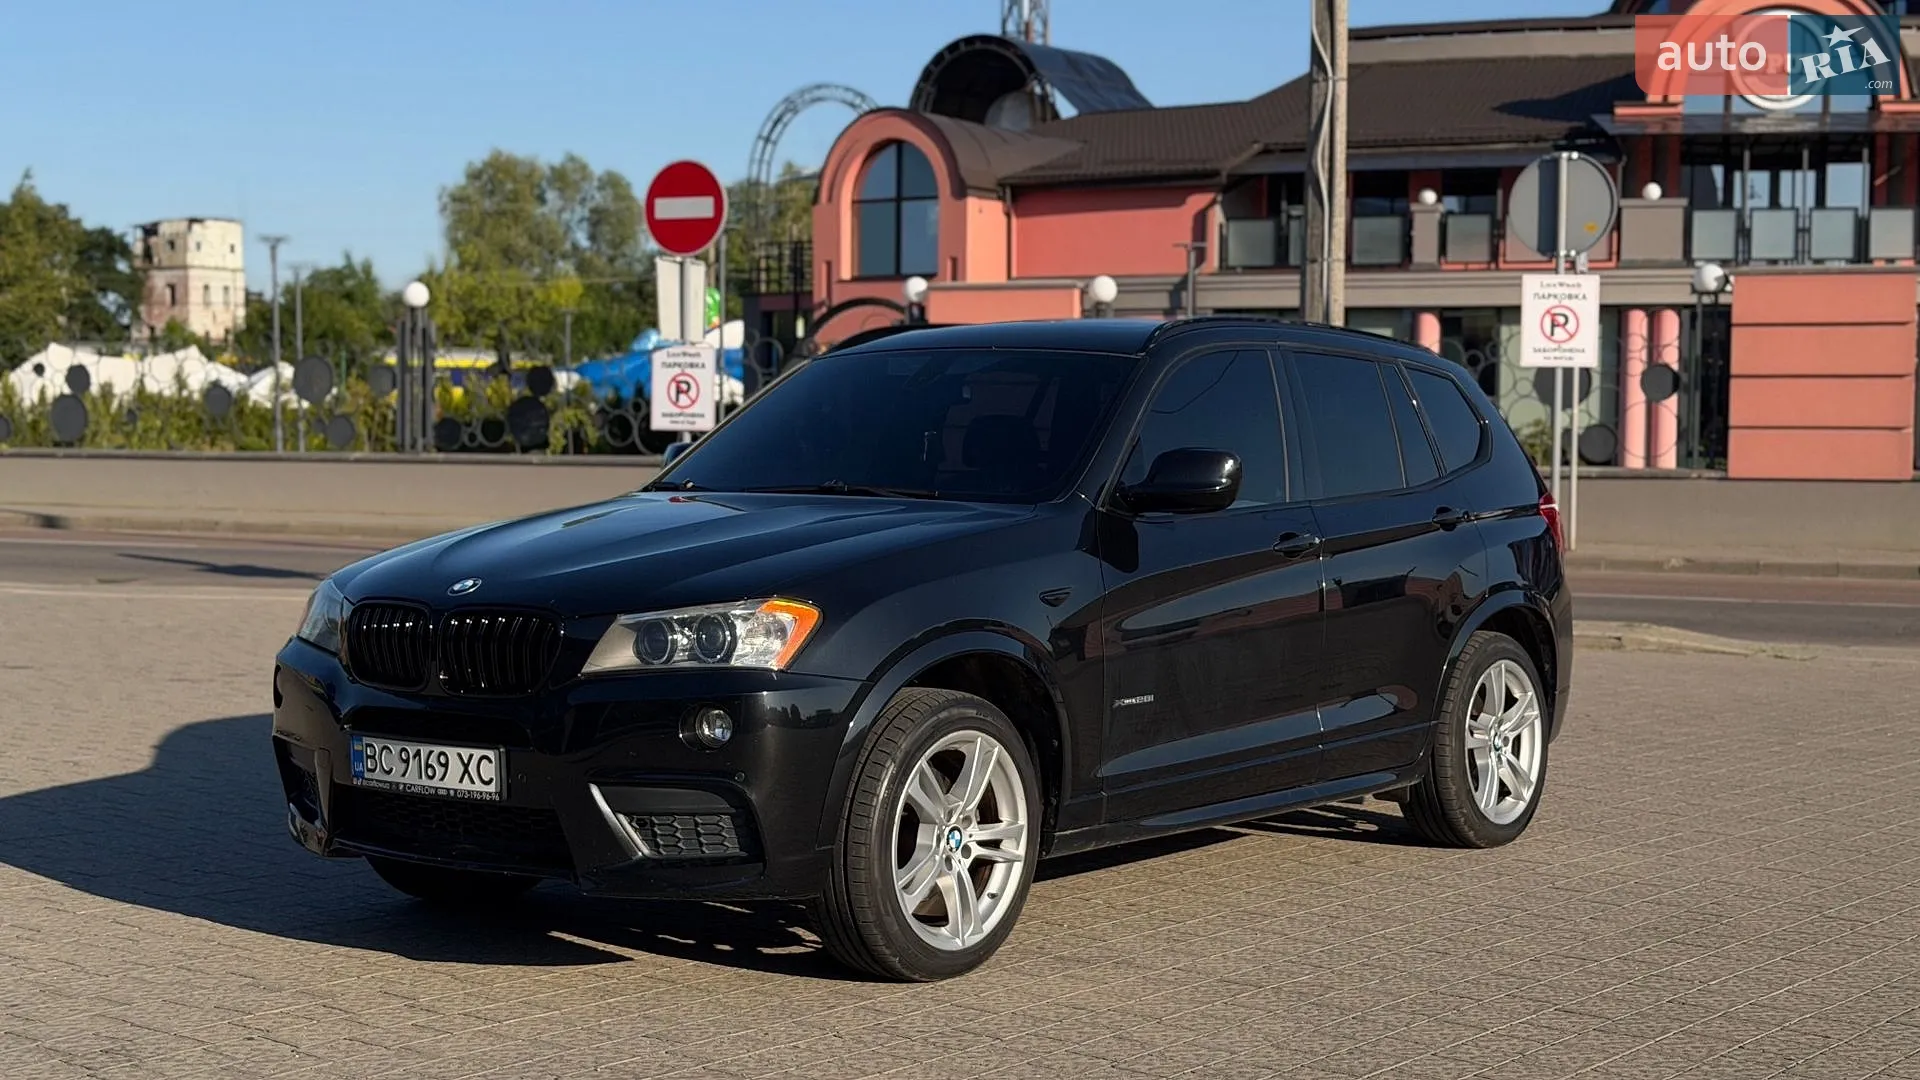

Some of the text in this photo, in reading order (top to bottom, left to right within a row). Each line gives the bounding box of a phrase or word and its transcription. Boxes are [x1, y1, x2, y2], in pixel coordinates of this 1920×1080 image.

[354, 761, 364, 772] UA
[365, 742, 495, 786] BC 9169 XC
[405, 784, 436, 795] CARFLOW
[457, 789, 500, 801] 073-196-96-96
